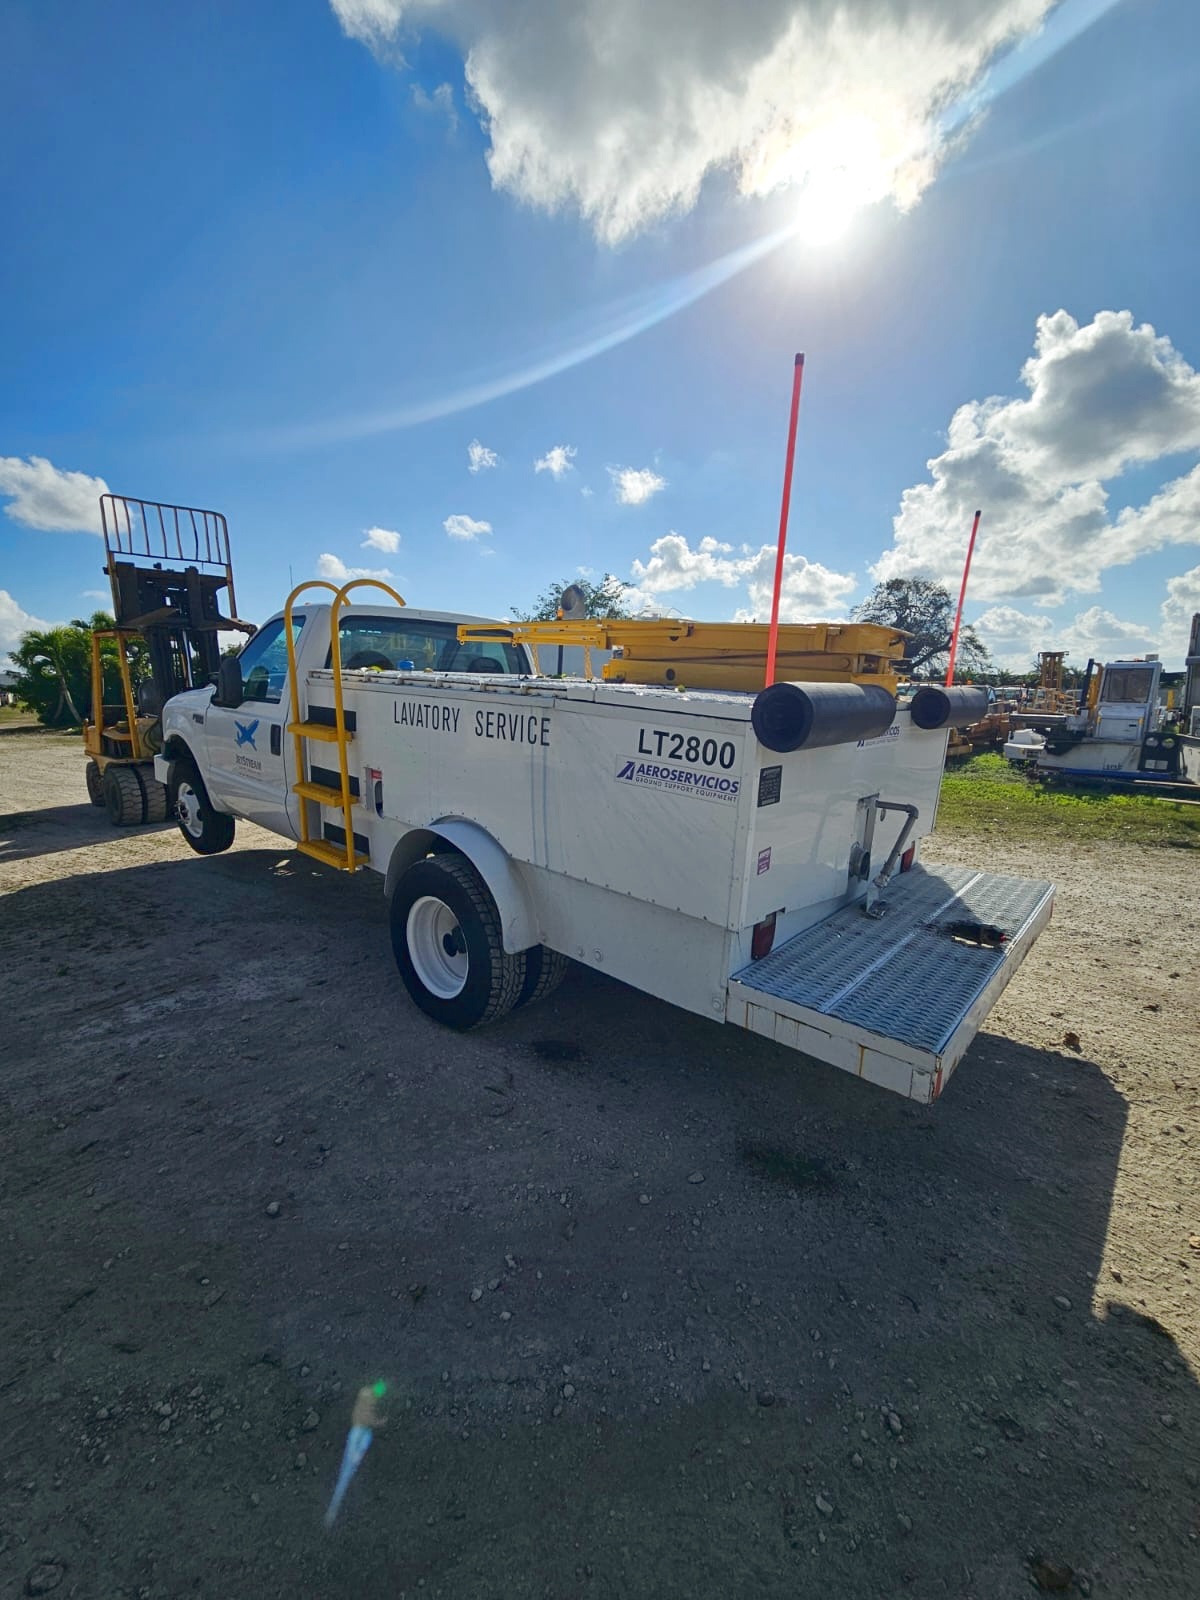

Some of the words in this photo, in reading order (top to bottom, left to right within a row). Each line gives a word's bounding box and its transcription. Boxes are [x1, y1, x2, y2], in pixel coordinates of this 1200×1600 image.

[394, 701, 460, 732] LAVATORY
[475, 710, 550, 746] SERVICE
[638, 728, 736, 769] LT2800
[635, 777, 662, 787] GROUND
[664, 782, 693, 793] SUPPORT
[695, 788, 737, 803] EQUIPMENT
[636, 763, 739, 794] AEROSERVICIOS
